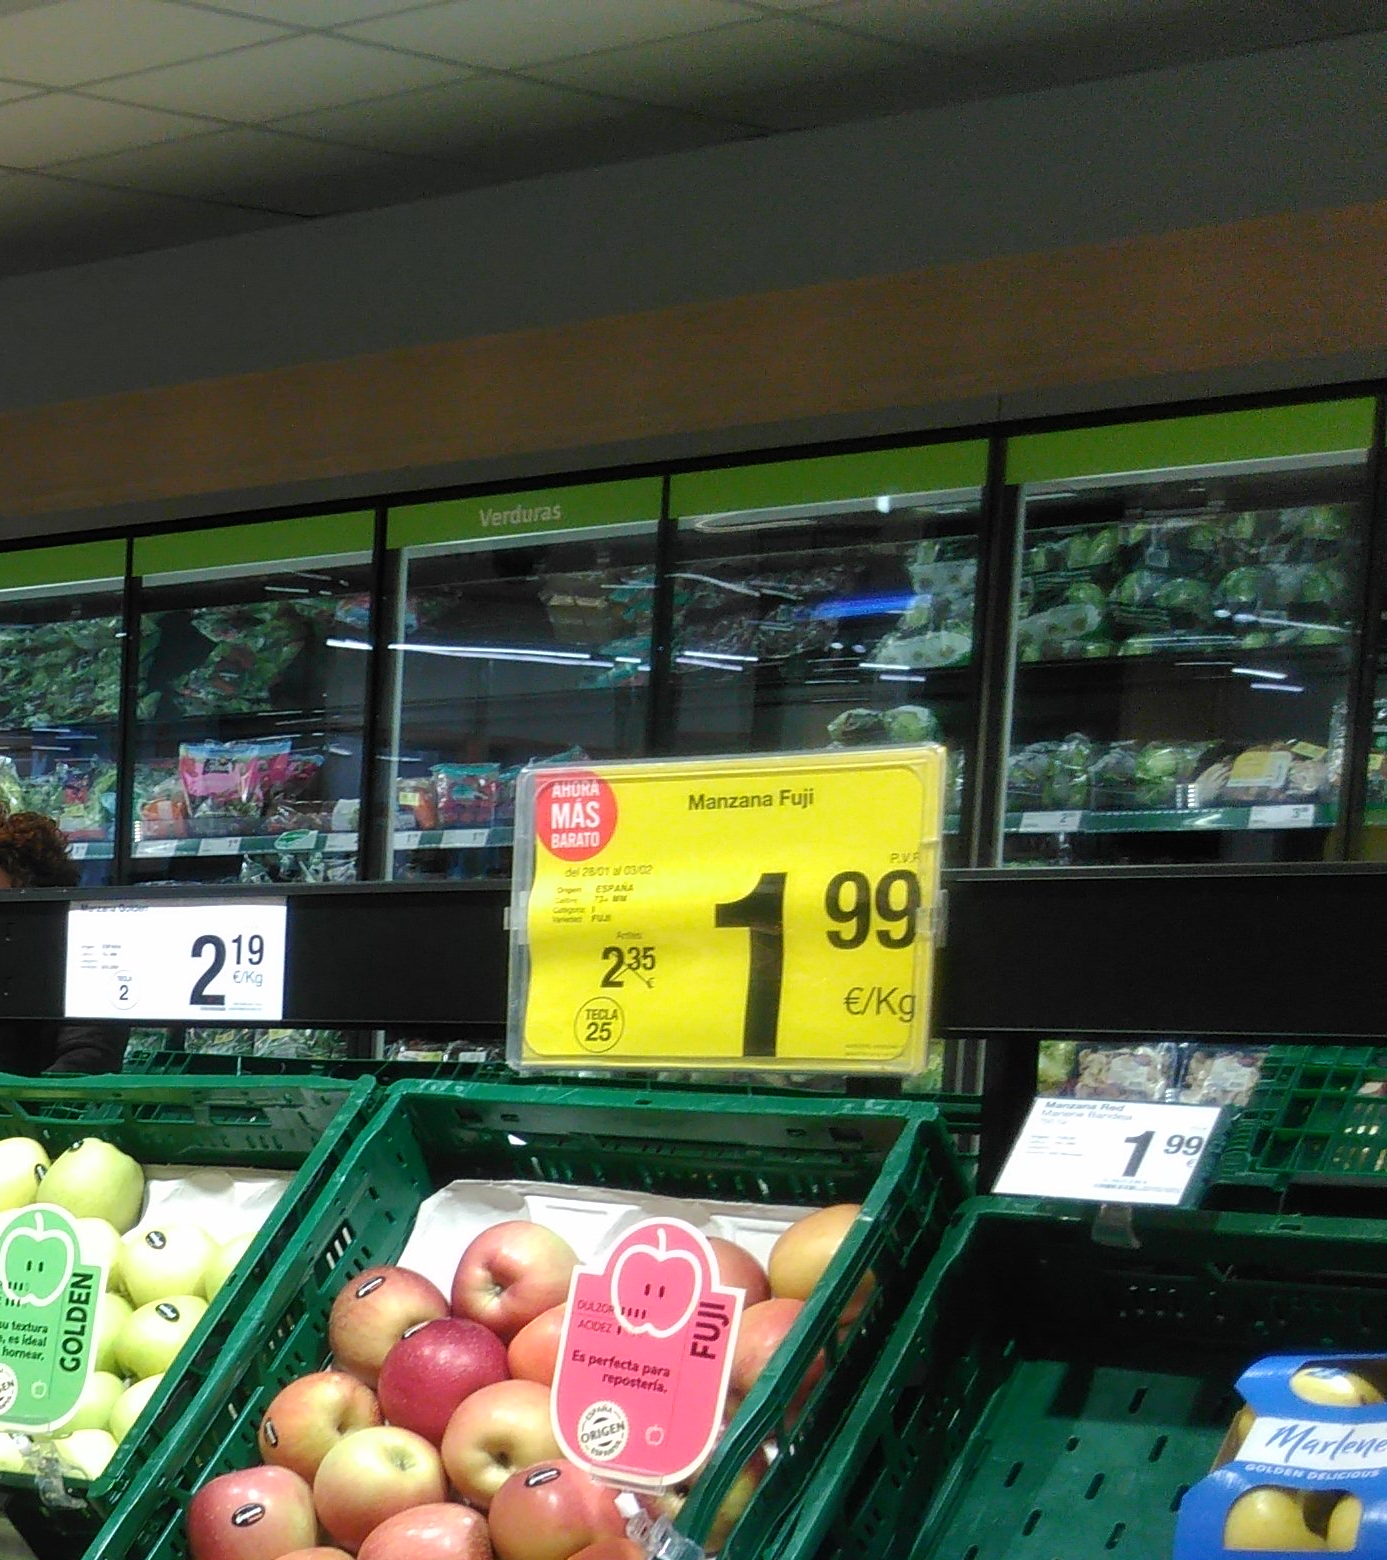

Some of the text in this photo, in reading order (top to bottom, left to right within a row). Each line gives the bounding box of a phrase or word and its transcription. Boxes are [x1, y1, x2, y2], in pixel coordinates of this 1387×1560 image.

[479, 500, 561, 528] Verduras
[551, 780, 601, 799] AHORA
[688, 788, 815, 812] Manzana Fuji
[551, 798, 601, 830] MÁS
[551, 831, 600, 849] BARATO
[189, 934, 264, 1006] 2 19
[600, 946, 657, 989] 2 35
[714, 869, 922, 1058] 1 99
[233, 970, 263, 987] €/Kg
[119, 984, 129, 1001] 2
[585, 1007, 618, 1022] TECLA
[843, 987, 915, 1022] €/Kg
[585, 1022, 612, 1043] 25
[1100, 1103, 1125, 1112] Red
[1122, 1130, 1156, 1177] 1
[1163, 1134, 1204, 1157] 99
[11, 1319, 48, 1335] textura
[59, 1271, 94, 1373] GOLDEN
[577, 1319, 612, 1334] ACIDEZ
[690, 1301, 730, 1360] FUJI
[8, 1336, 20, 1346] es
[21, 1333, 47, 1348] ideal
[1, 1345, 45, 1362] hornear.
[572, 1350, 671, 1379] Es perfecta para
[601, 1371, 668, 1394] repostería.
[580, 1421, 626, 1444] ORIGEN
[1264, 1424, 1387, 1464] Marlene
[1245, 1463, 1380, 1481] GOLDEN DELICIOUS
